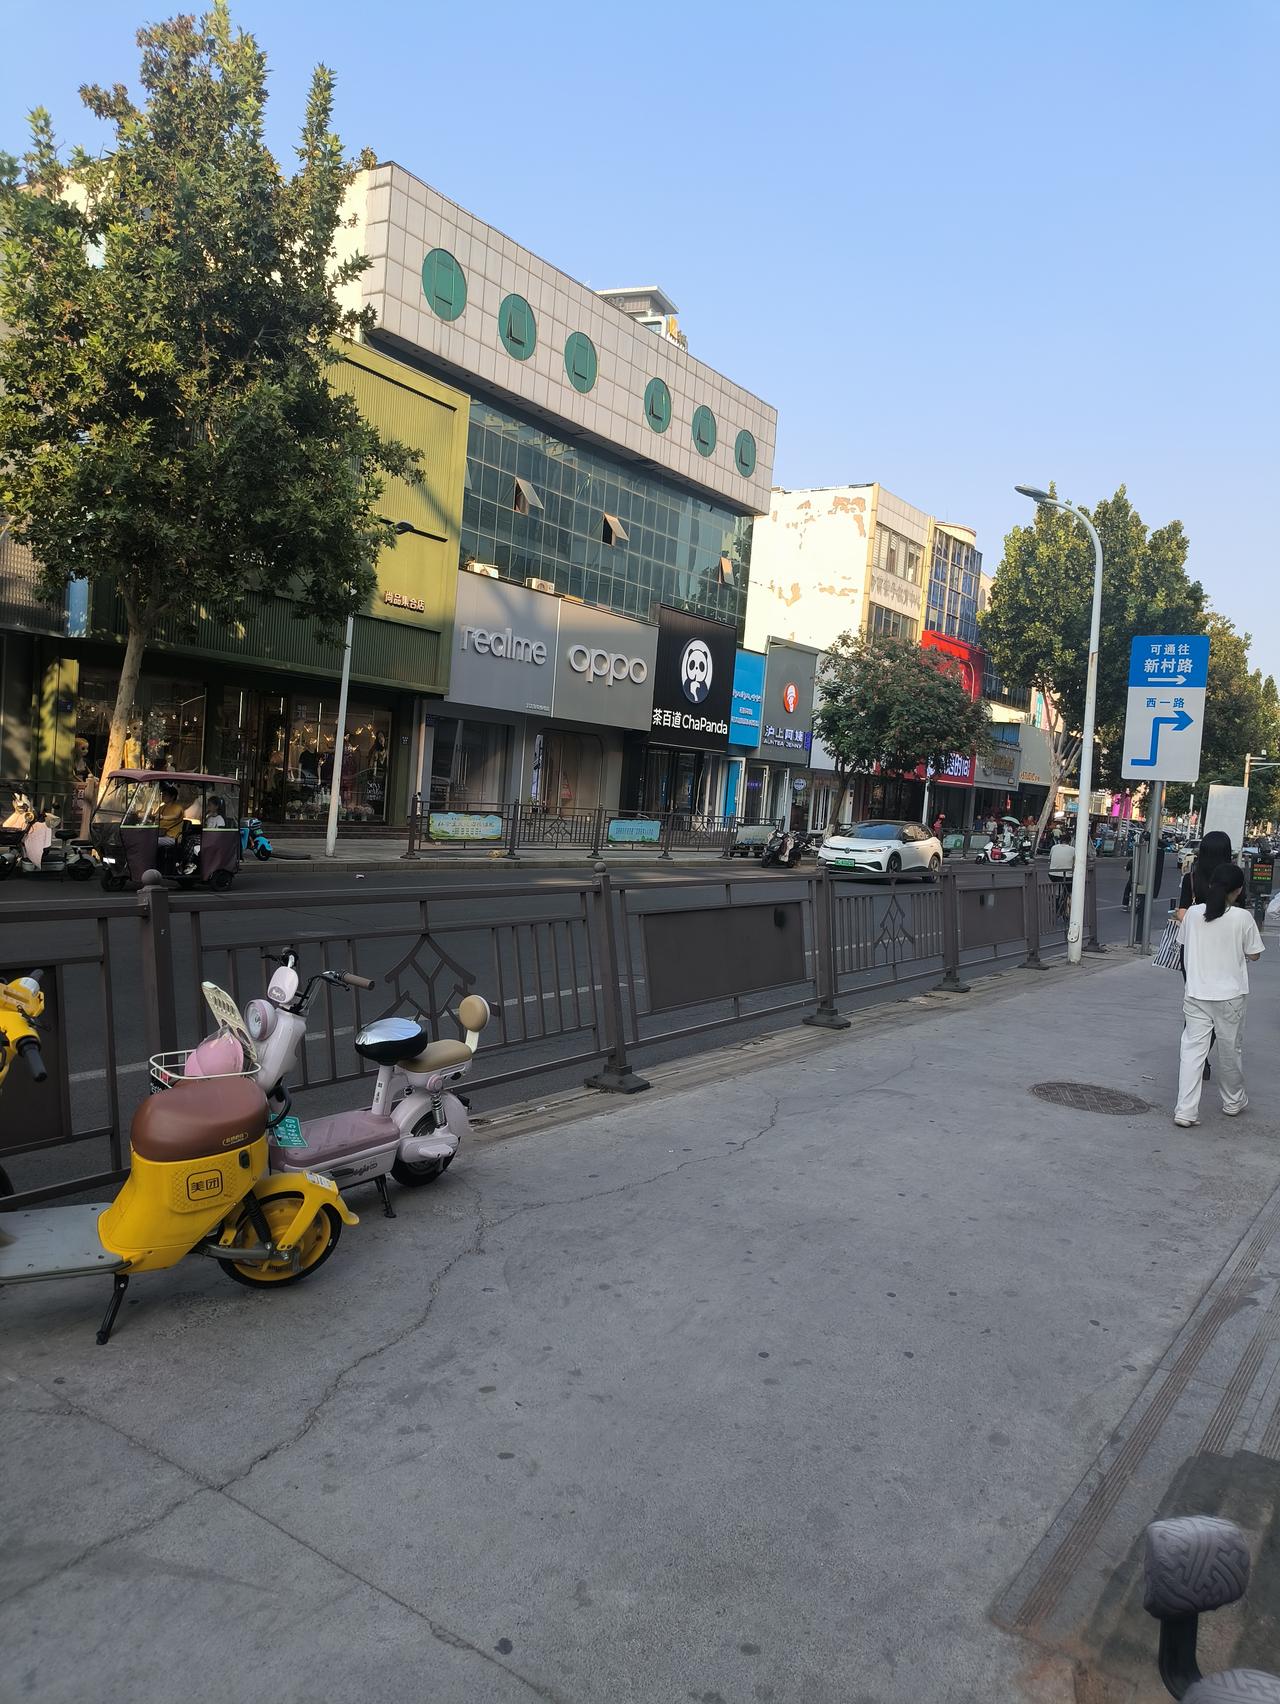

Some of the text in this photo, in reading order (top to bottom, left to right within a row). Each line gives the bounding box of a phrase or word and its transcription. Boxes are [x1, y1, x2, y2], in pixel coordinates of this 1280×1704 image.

[459, 624, 548, 666] realme
[1150, 643, 1190, 656] 可通往
[569, 644, 648, 687] oppo
[1144, 658, 1193, 673] 新村路
[1145, 697, 1185, 709] 西一路
[652, 707, 682, 729] 茶百道
[682, 714, 728, 735] ChaPanda
[191, 1177, 219, 1193] 美团
